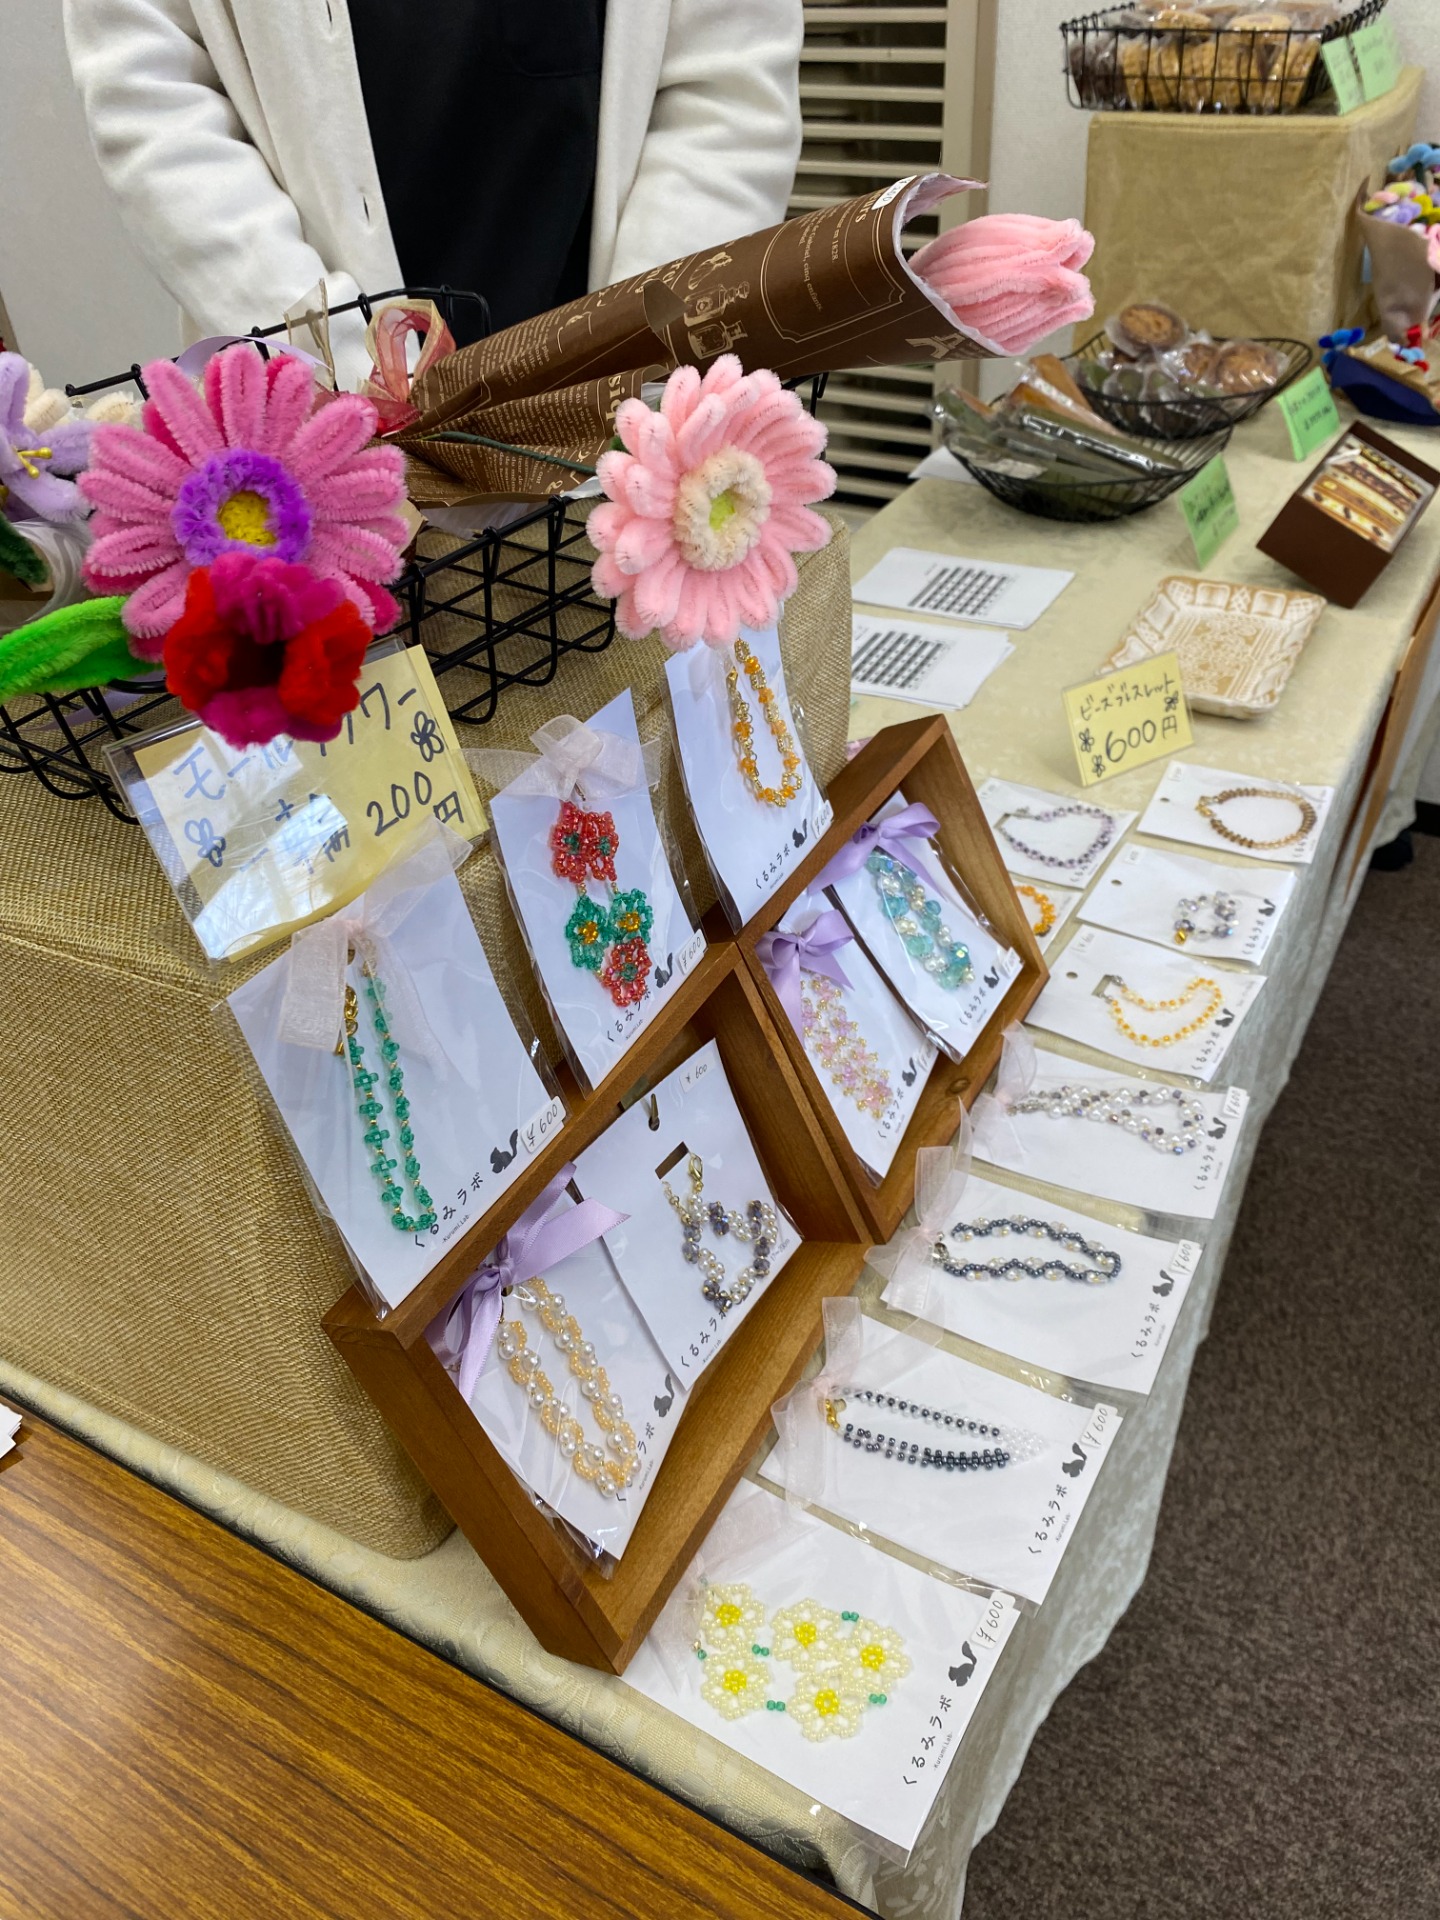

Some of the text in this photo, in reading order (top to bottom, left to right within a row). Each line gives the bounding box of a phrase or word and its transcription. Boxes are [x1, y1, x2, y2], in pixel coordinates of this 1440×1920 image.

[1080, 672, 1176, 722] ビーズブレスレット
[173, 682, 417, 800] モールワー
[1105, 715, 1179, 763] 600円
[755, 843, 790, 890] くるみラボ
[680, 936, 701, 970] ¥600
[525, 1103, 559, 1148] ¥600
[1130, 1302, 1161, 1359] くるみラボ
[1027, 1483, 1068, 1555] くるみラボ
[976, 1599, 1004, 1644] ¥600
[902, 1693, 953, 1786] くるみラボ
